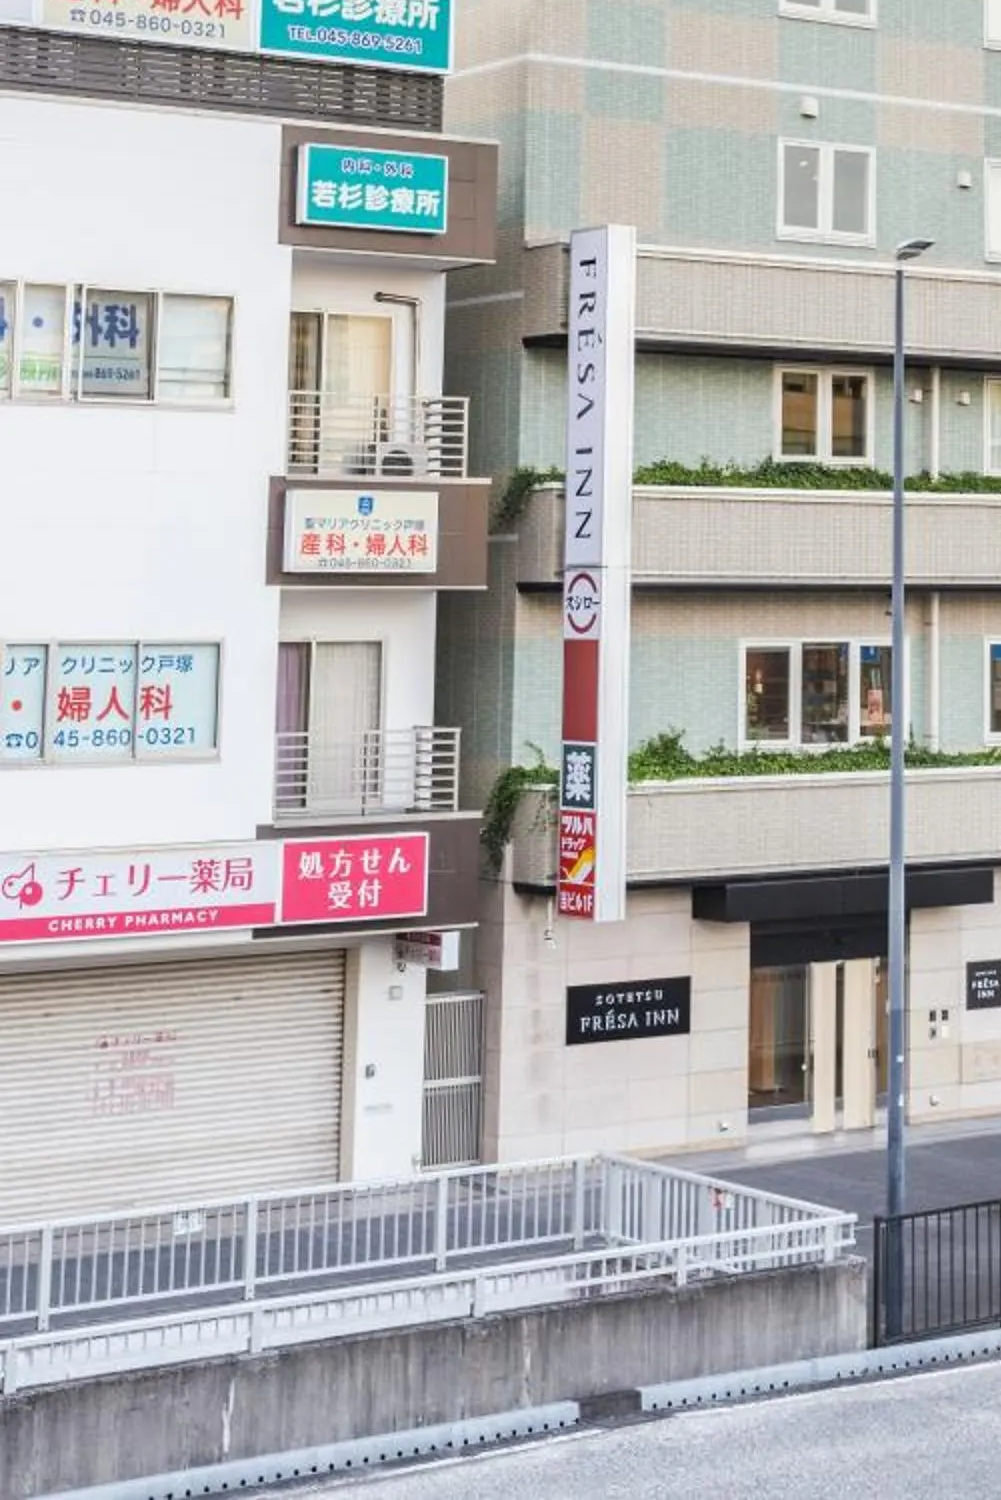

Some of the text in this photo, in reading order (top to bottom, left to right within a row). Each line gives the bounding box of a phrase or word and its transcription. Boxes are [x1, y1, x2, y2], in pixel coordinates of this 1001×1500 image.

[90, 8, 225, 39] 045-860-0321
[311, 180, 440, 217] 若杉診療所
[574, 257, 603, 539] FRÉSA INN
[301, 533, 428, 556] 産科・婦人科
[566, 596, 600, 611] スシロー
[565, 751, 592, 801] 薬
[561, 816, 592, 835] ツルハ
[58, 857, 254, 900] チェリー薬局
[298, 847, 411, 880] 処方せん
[328, 878, 383, 909] 受付
[48, 910, 219, 932] CHERRY PHARMACY
[595, 989, 663, 1006] SOTETSU
[580, 1007, 679, 1033] FRÉSA INN
